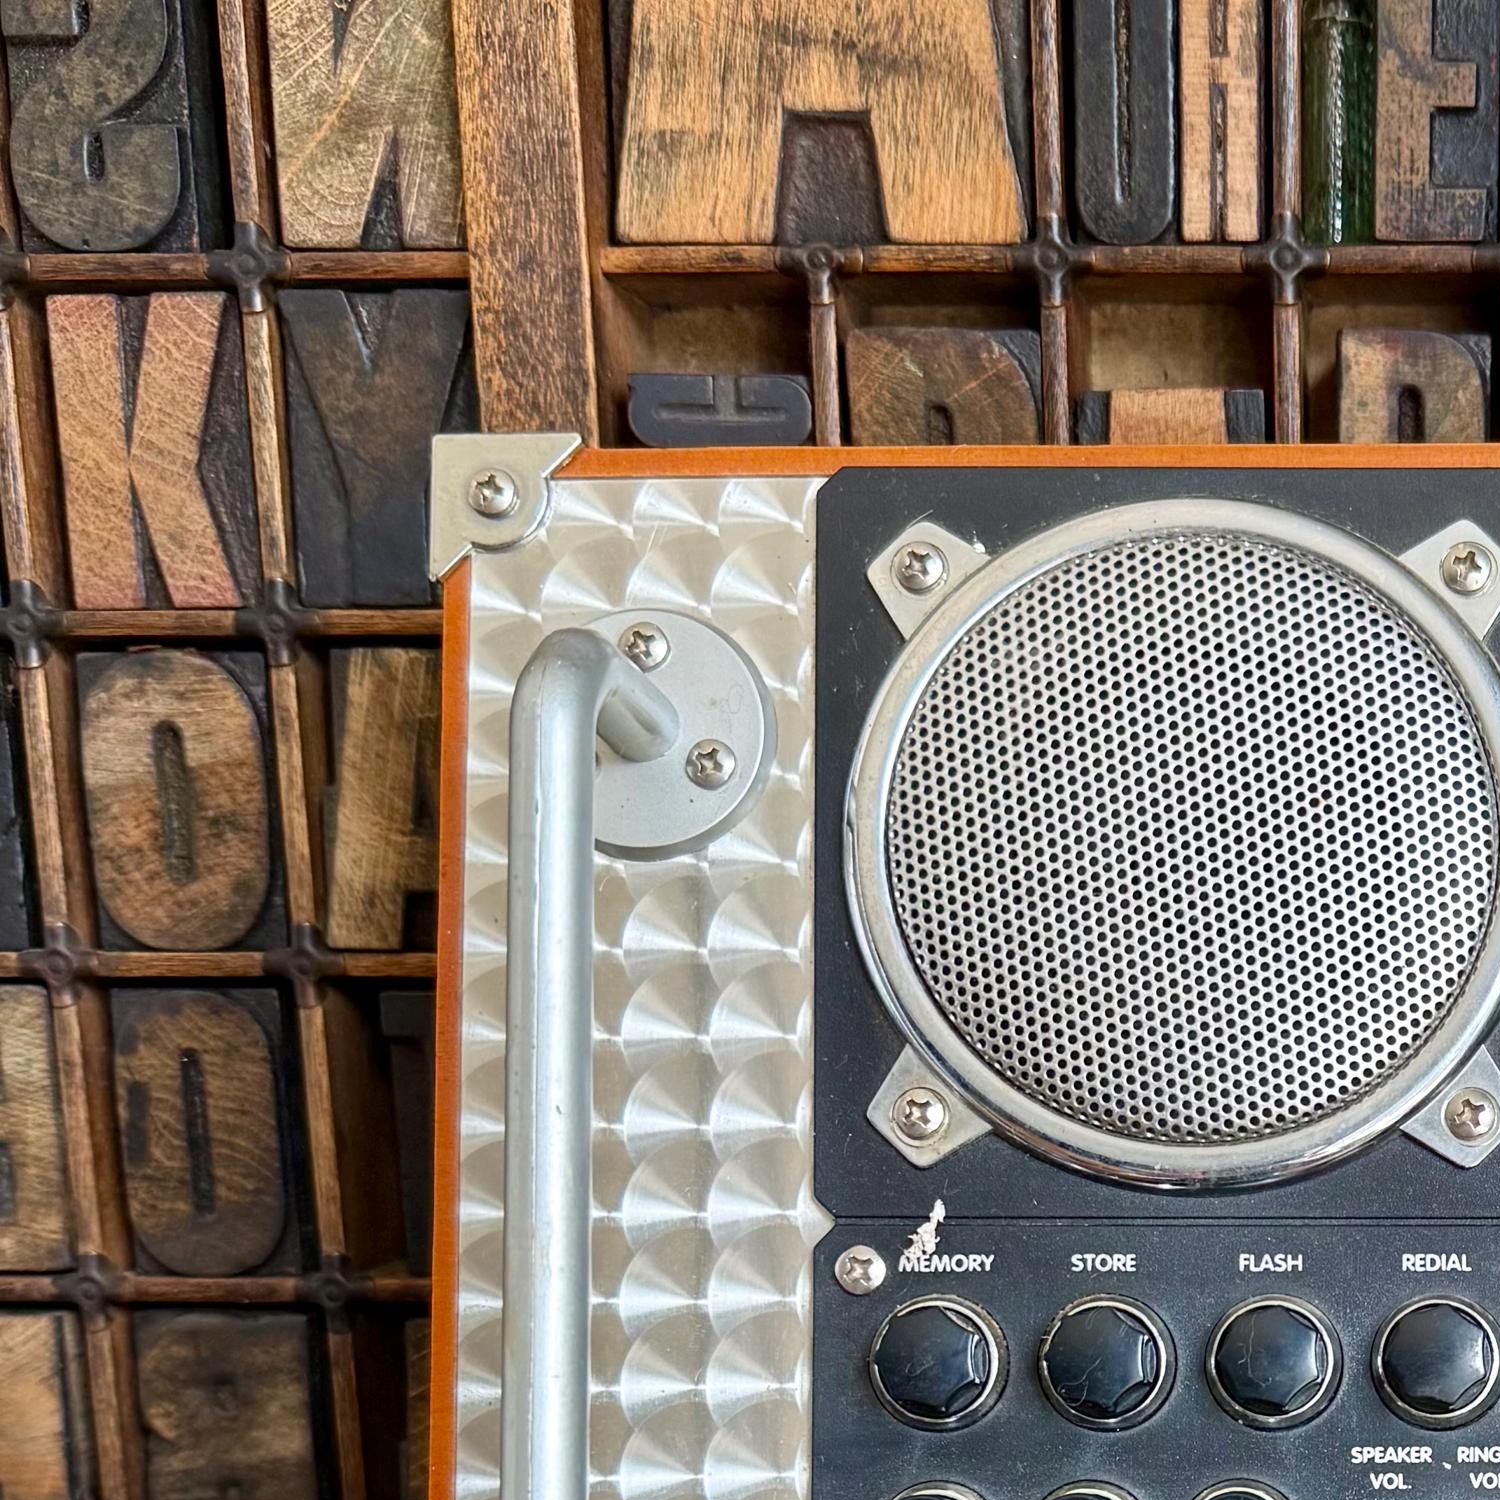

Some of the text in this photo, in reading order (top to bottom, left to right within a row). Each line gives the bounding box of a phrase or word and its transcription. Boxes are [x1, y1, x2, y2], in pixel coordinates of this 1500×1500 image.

[899, 1253, 995, 1272] MEMORY
[1071, 1253, 1137, 1272] STORE
[1238, 1253, 1303, 1272] FLASH
[1402, 1253, 1473, 1272] REDIAL
[1350, 1446, 1433, 1464] SPEAKER
[1370, 1473, 1412, 1490] VOL.
